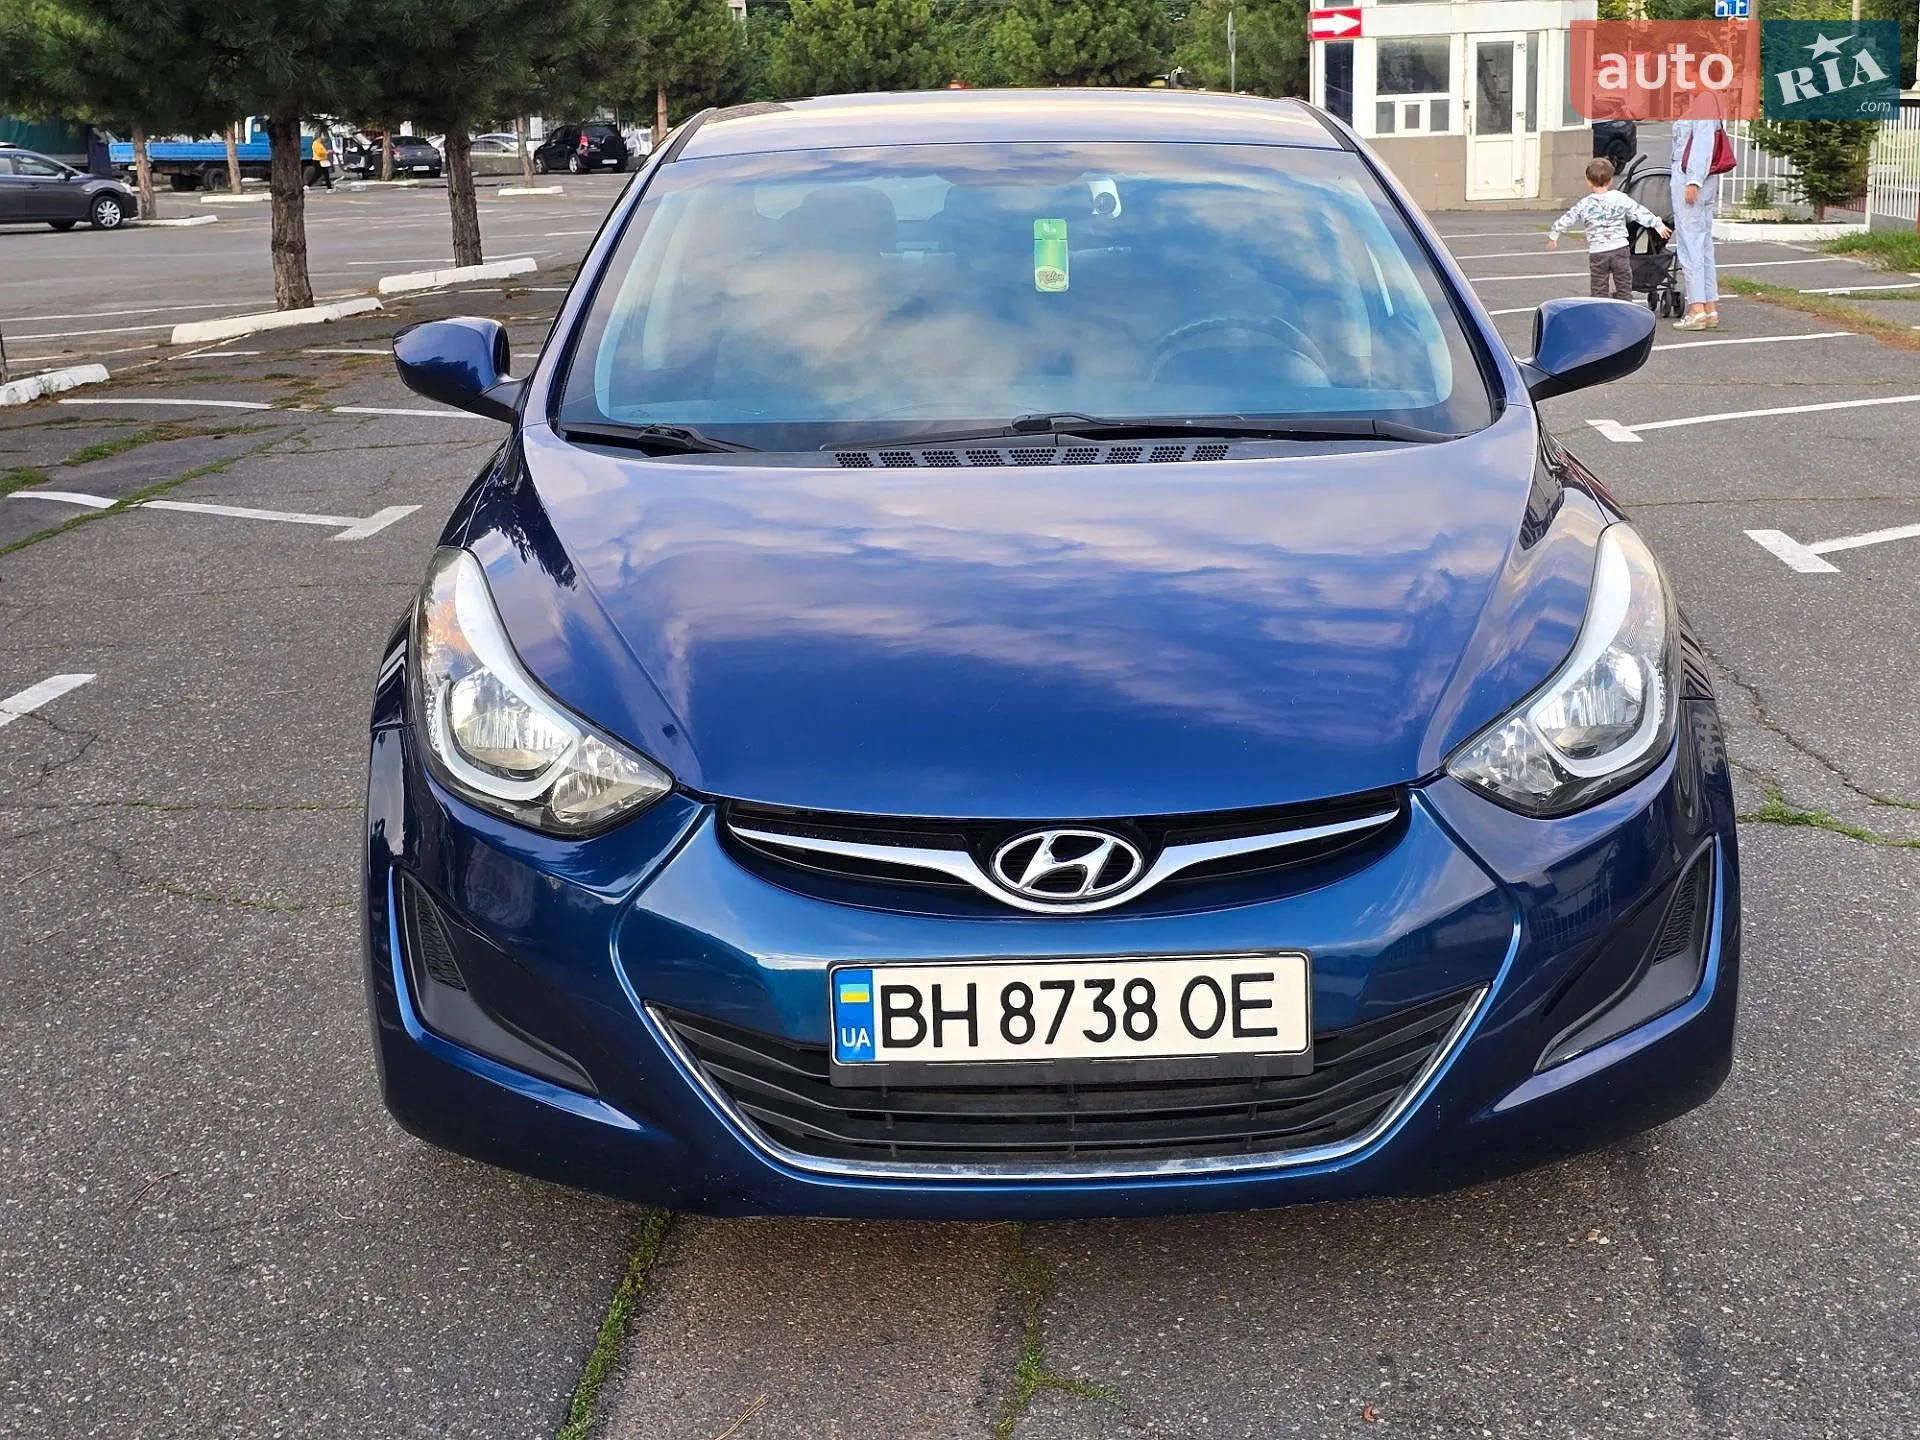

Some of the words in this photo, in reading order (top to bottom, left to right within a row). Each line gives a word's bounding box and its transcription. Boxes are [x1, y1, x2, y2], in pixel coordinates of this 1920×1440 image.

[881, 983, 978, 1048] BH
[1000, 977, 1158, 1044] 8738
[1180, 972, 1278, 1039] OE
[841, 1027, 871, 1047] UA
